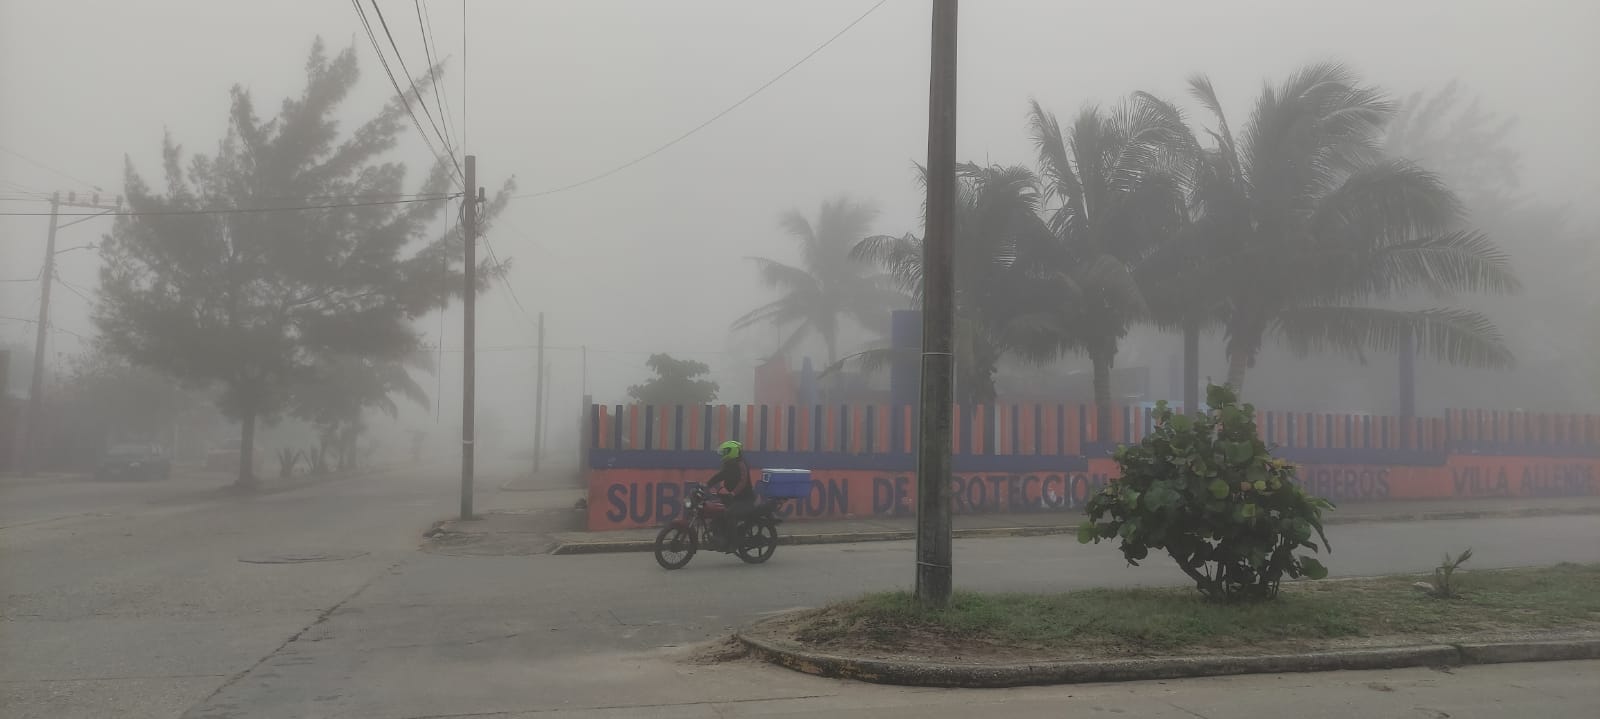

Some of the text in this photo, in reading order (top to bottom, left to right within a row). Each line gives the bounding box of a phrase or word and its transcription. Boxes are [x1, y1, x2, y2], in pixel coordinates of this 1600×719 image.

[873, 476, 910, 515] DE
[949, 471, 1108, 512] ROTECCIO
[1295, 466, 1391, 498] MBEROS
[1453, 465, 1509, 496] VILLA
